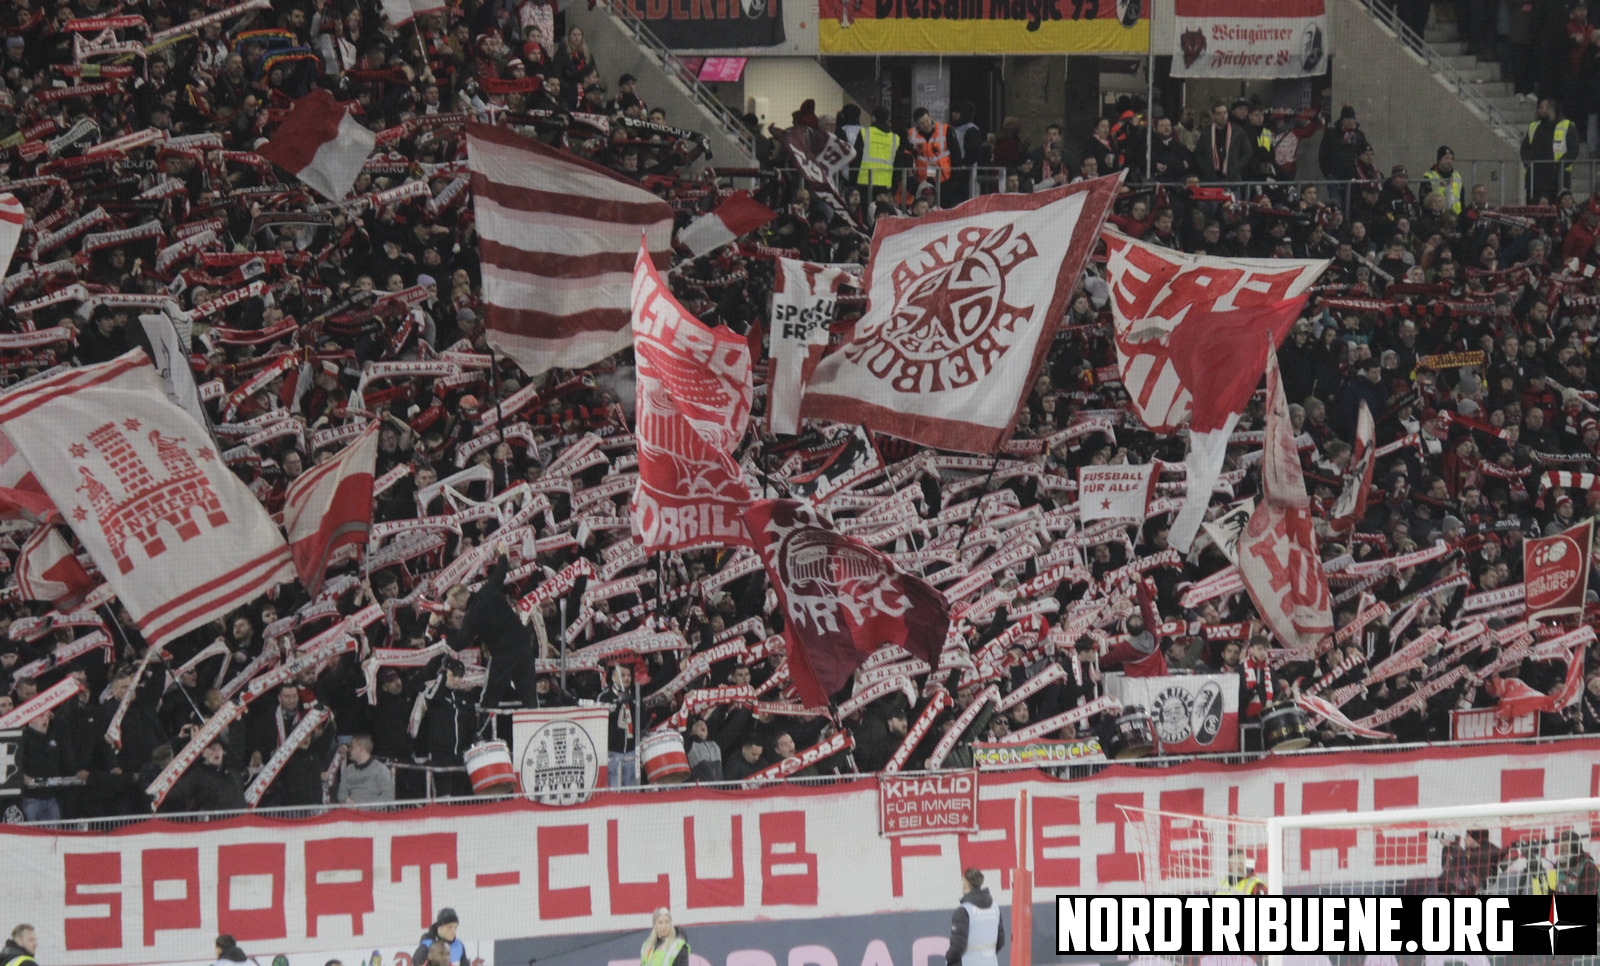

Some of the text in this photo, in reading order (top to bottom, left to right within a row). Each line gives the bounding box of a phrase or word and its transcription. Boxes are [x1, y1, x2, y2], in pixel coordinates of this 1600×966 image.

[372, 364, 455, 375] FREIBURG
[1006, 439, 1042, 451] REIBURG
[1083, 471, 1144, 483] FUSSBALL
[1083, 483, 1139, 493] FÜR ALLE
[105, 485, 217, 546] SYNTHESIA
[702, 556, 758, 592] FREIBUR
[1110, 551, 1181, 583] FREIBURG
[1467, 588, 1524, 606] FREIBUR
[866, 662, 924, 681] FREIBU
[535, 775, 585, 785] SYNTHESIA
[886, 777, 971, 799] KHALID
[886, 799, 971, 816] FÜR IMMER
[899, 813, 960, 828] BEI UNS
